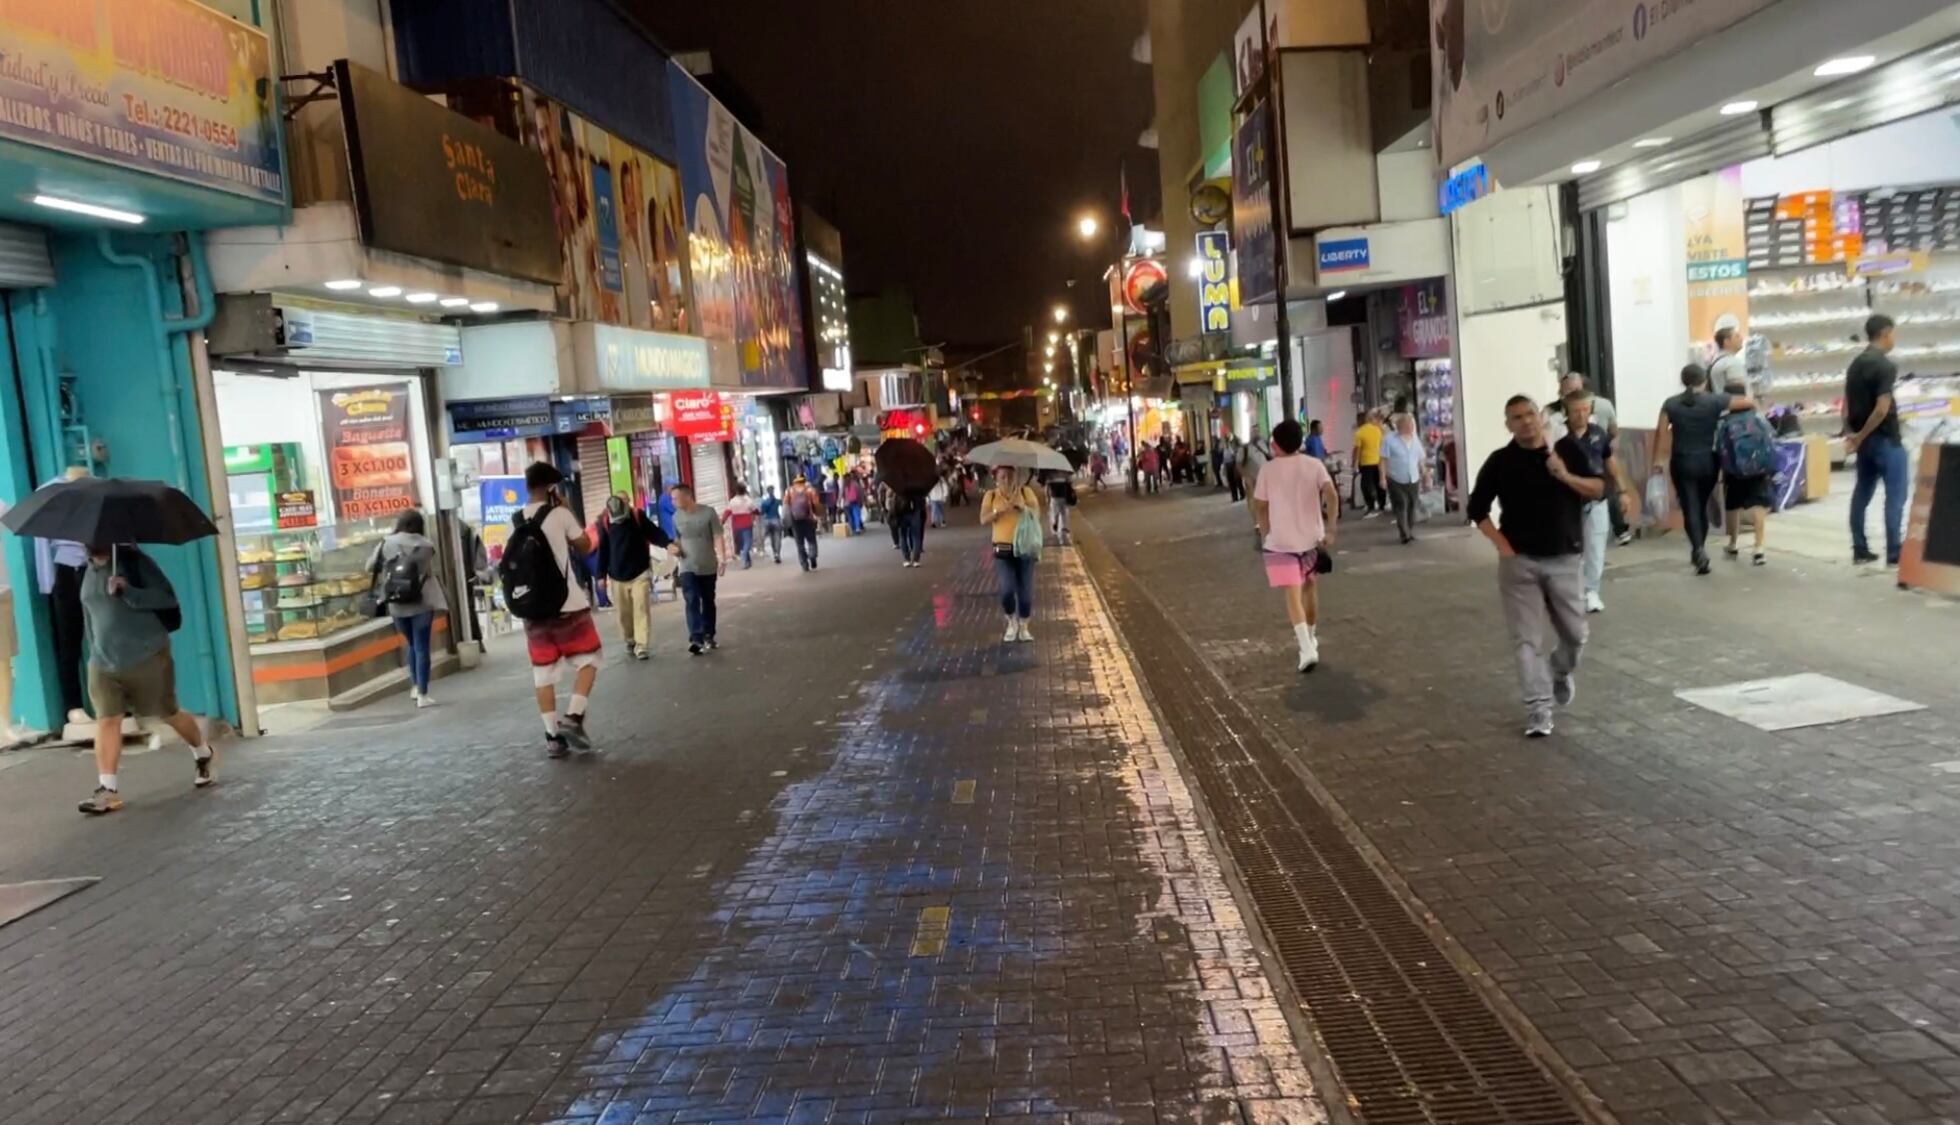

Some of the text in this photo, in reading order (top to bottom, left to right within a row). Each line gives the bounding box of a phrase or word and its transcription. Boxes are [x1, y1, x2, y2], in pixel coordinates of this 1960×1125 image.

[442, 133, 495, 184] Santa
[455, 172, 493, 207] Clara
[1321, 249, 1367, 263] LIBERTY
[1688, 262, 1742, 281] ESTOS
[675, 396, 711, 410] Claro
[340, 463, 349, 477] 3
[344, 502, 359, 514] 10
